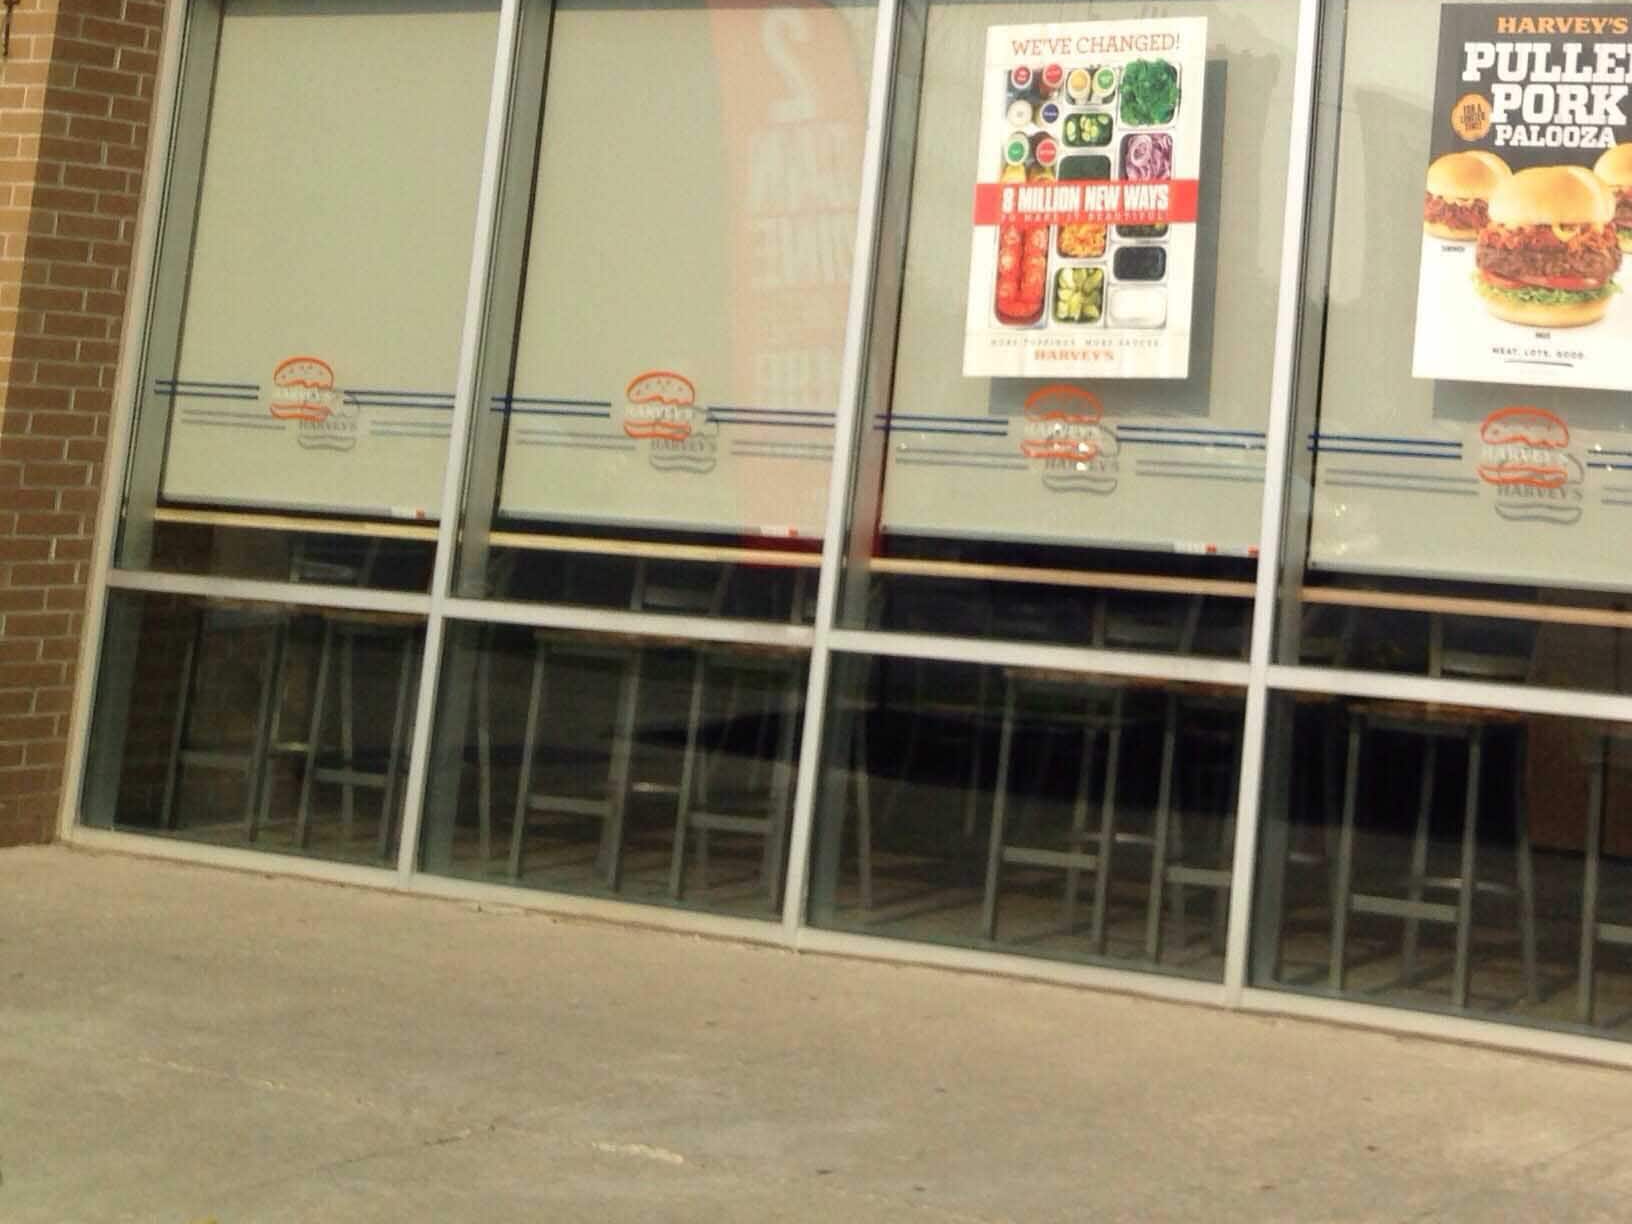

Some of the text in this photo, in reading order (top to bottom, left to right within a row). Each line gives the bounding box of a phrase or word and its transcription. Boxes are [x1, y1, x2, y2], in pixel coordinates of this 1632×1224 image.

[1497, 17, 1629, 34] HARVEY'S
[1012, 33, 1181, 56] WE'VE CHANGED!
[1489, 84, 1629, 126] PORK
[1494, 124, 1617, 147] PALOOZA
[1002, 184, 1169, 213] 8 MILLION NEW WAYS
[1034, 349, 1115, 361] HARVEY'S
